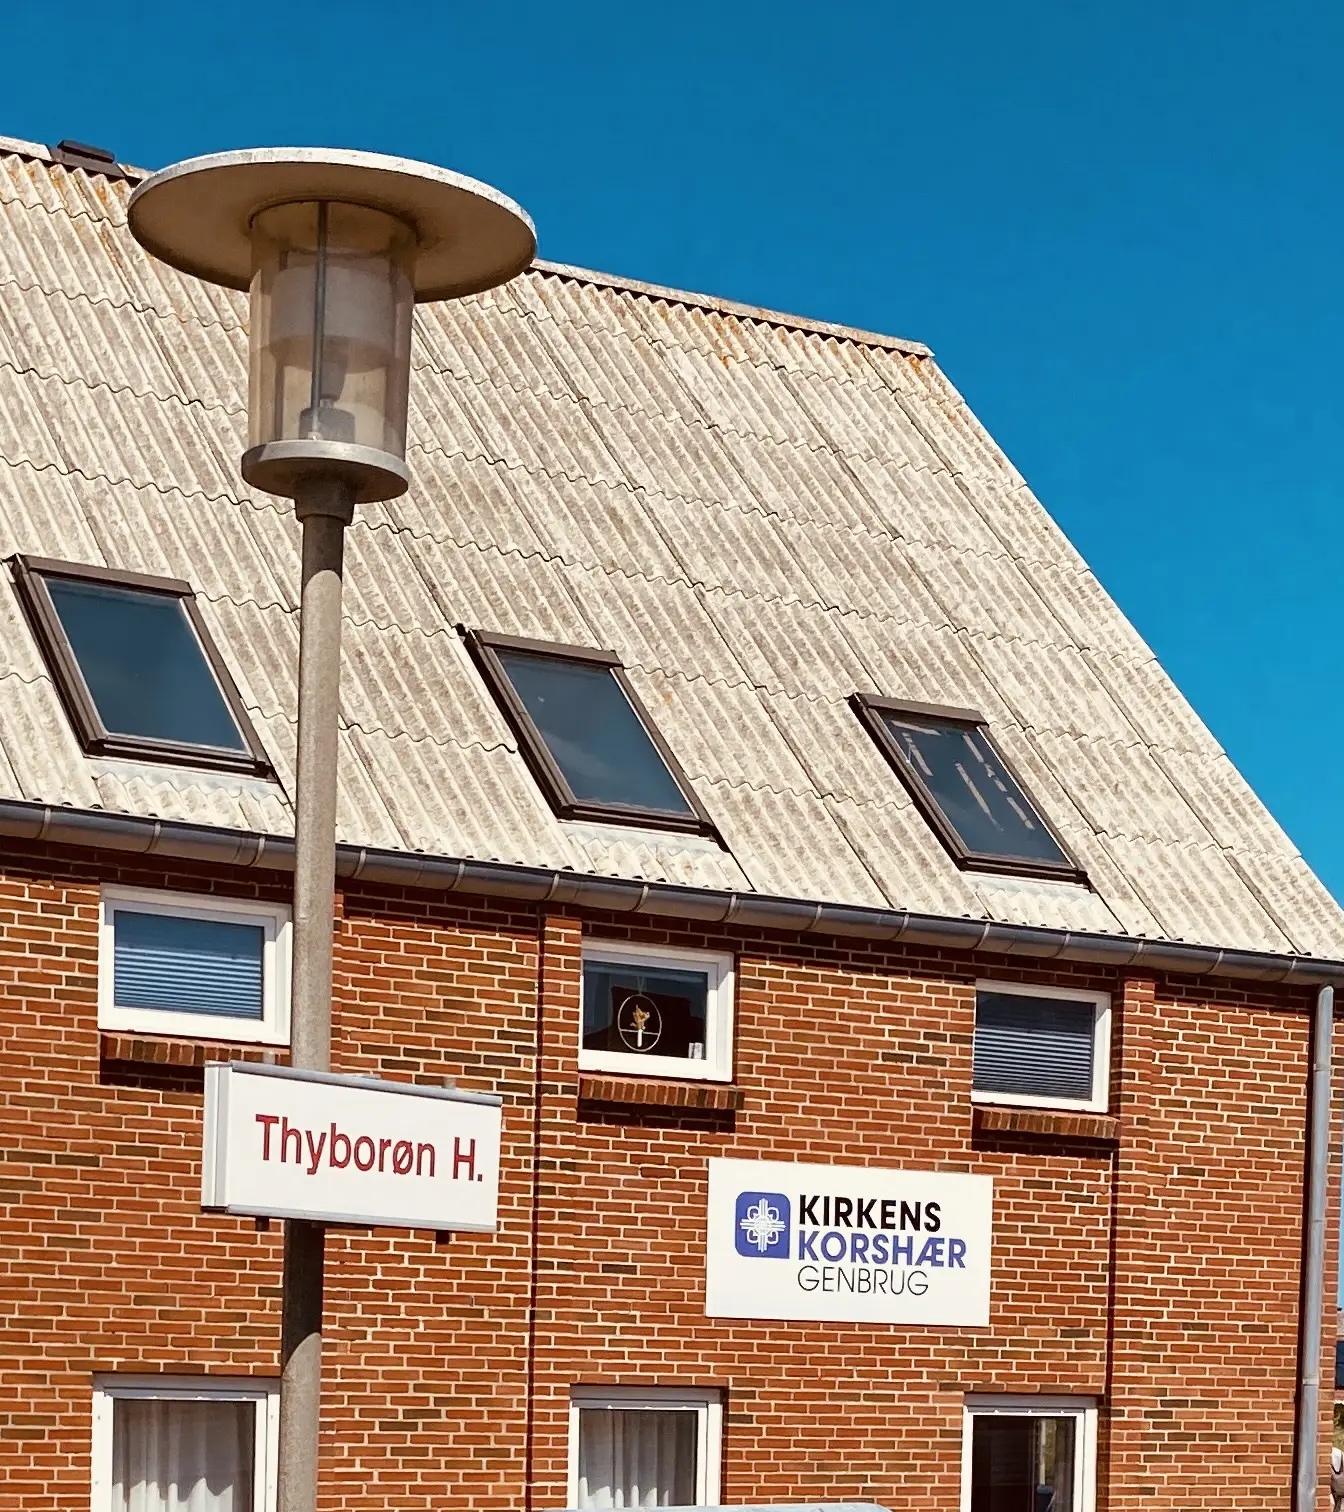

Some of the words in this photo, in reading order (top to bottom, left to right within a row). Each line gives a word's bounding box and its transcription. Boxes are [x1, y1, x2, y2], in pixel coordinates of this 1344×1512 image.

[256, 1113, 436, 1178] Thyborøn
[453, 1136, 483, 1182] H.
[799, 1194, 941, 1233] KIRKENS
[798, 1229, 967, 1269] KORSHÆR
[798, 1265, 928, 1296] GENBRUG
